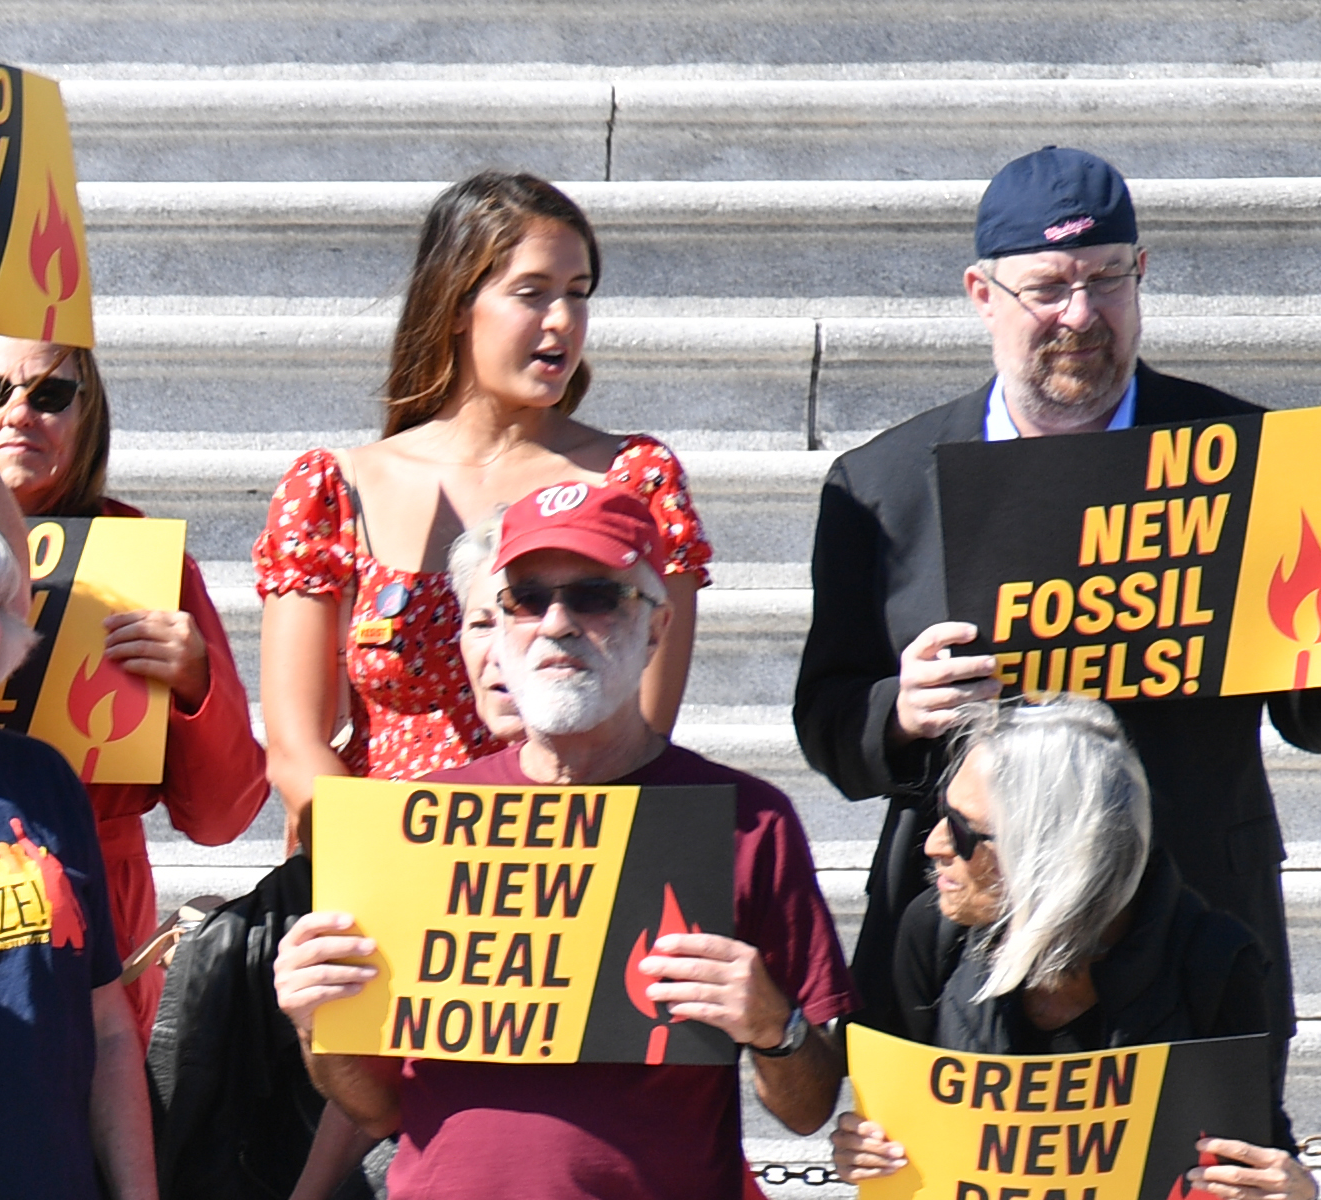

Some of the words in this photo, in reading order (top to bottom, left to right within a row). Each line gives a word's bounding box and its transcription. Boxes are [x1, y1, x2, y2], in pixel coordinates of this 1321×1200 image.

[1145, 423, 1238, 491] NO
[536, 482, 589, 517] W
[1078, 493, 1231, 567] NEW
[993, 565, 1214, 643] FOSSIL
[994, 636, 1205, 703] FUELS!
[402, 789, 610, 848] GREEN
[446, 861, 596, 918] NEW
[417, 929, 572, 988] DEAL
[389, 996, 560, 1057] NOW!
[929, 1052, 1139, 1113] GREEN
[977, 1118, 1130, 1176] NEW
